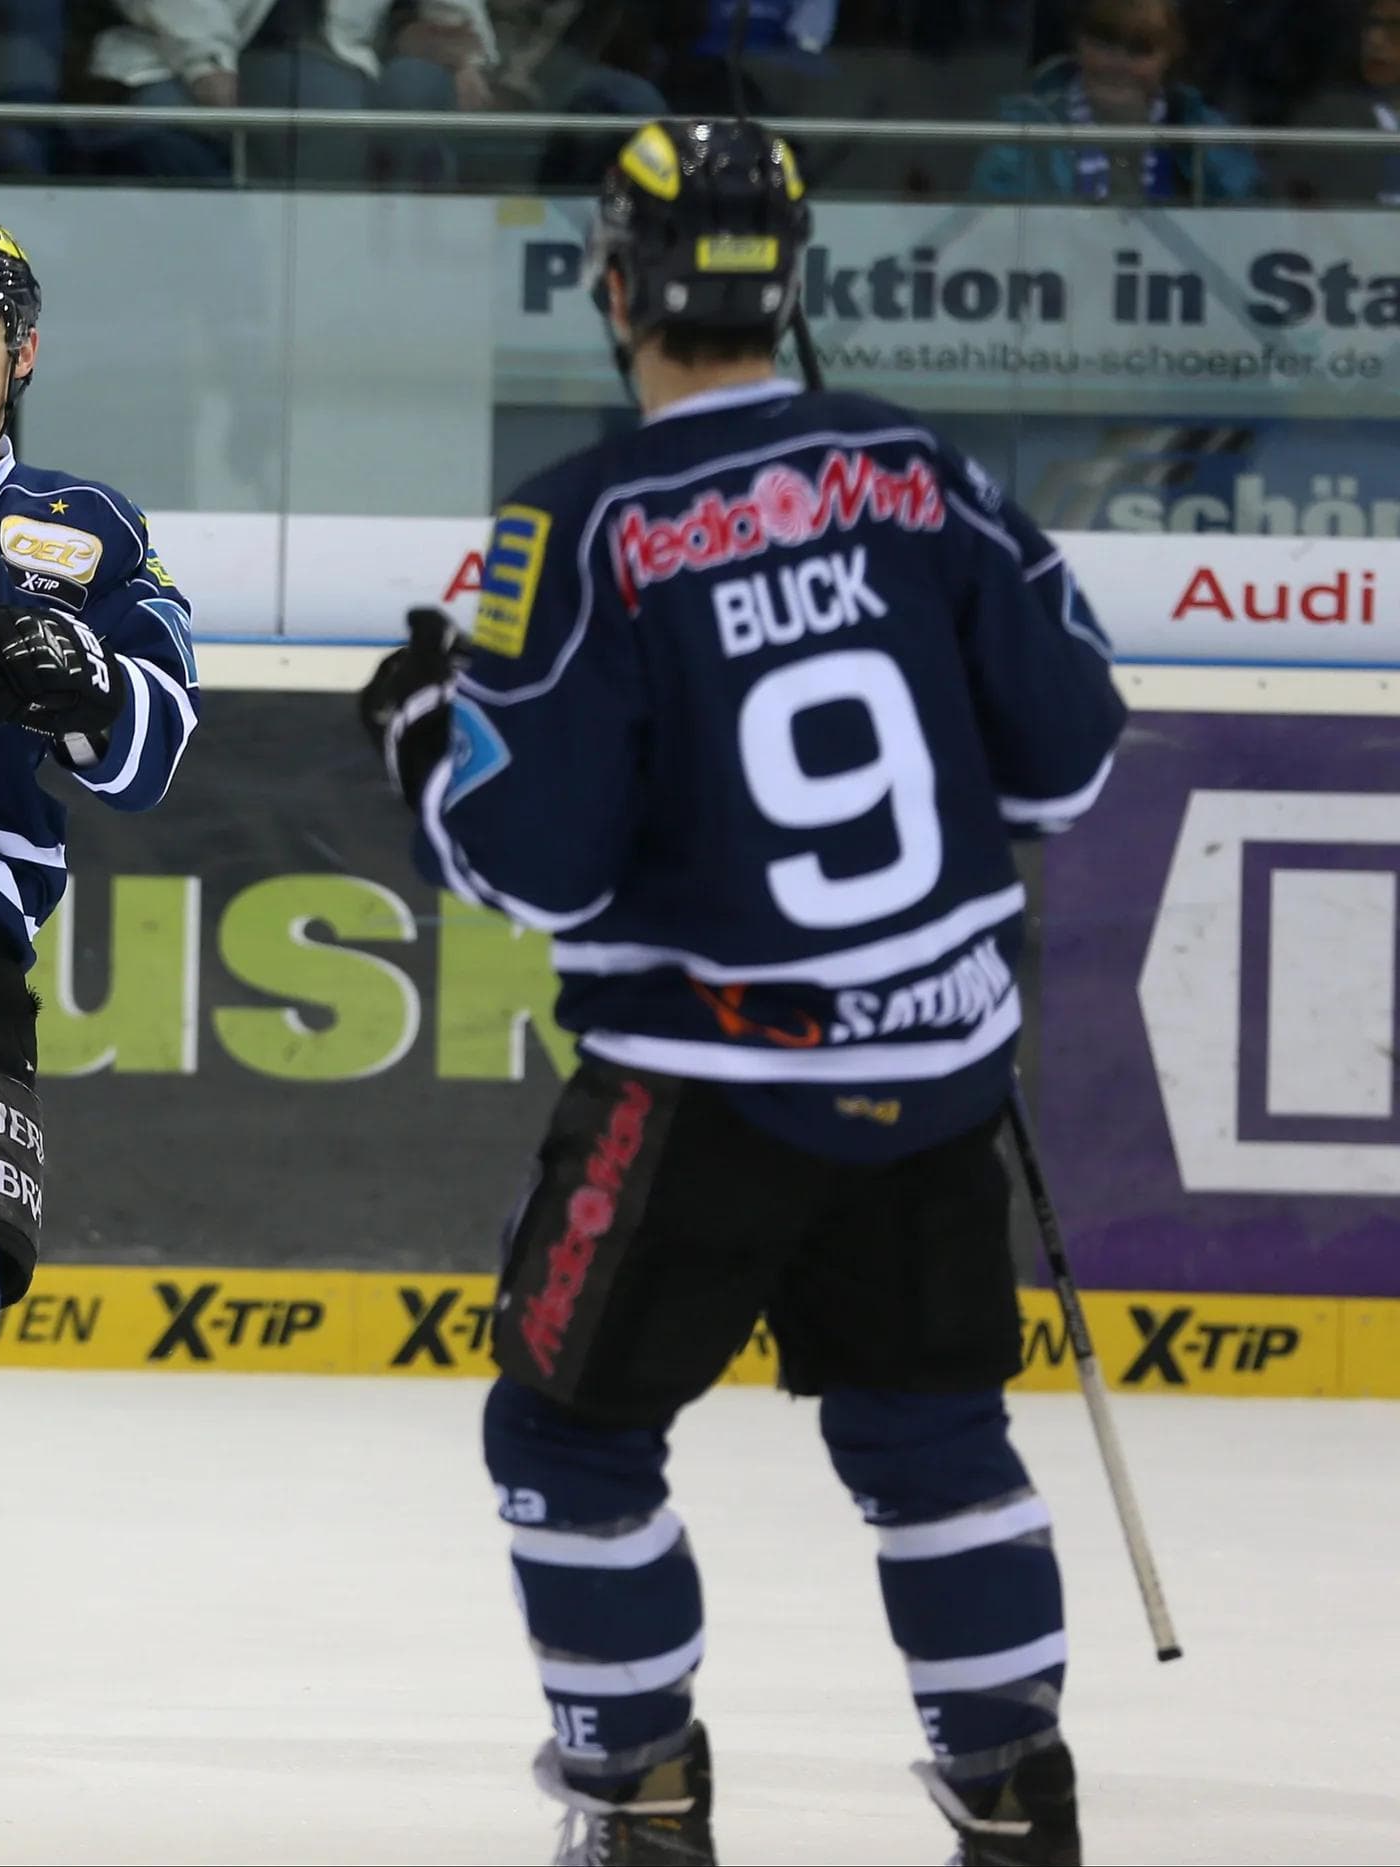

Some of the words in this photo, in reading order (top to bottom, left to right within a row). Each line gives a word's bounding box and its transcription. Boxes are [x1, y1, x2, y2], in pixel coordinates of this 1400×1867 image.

[1113, 248, 1206, 326] in
[1245, 250, 1400, 328] Sta
[7, 533, 93, 568] DEL
[712, 545, 888, 658] BUCK
[1171, 566, 1375, 624] Audi
[738, 649, 942, 929] 9
[146, 1281, 325, 1362] X-TiP
[1119, 1304, 1301, 1386] X-TiP
